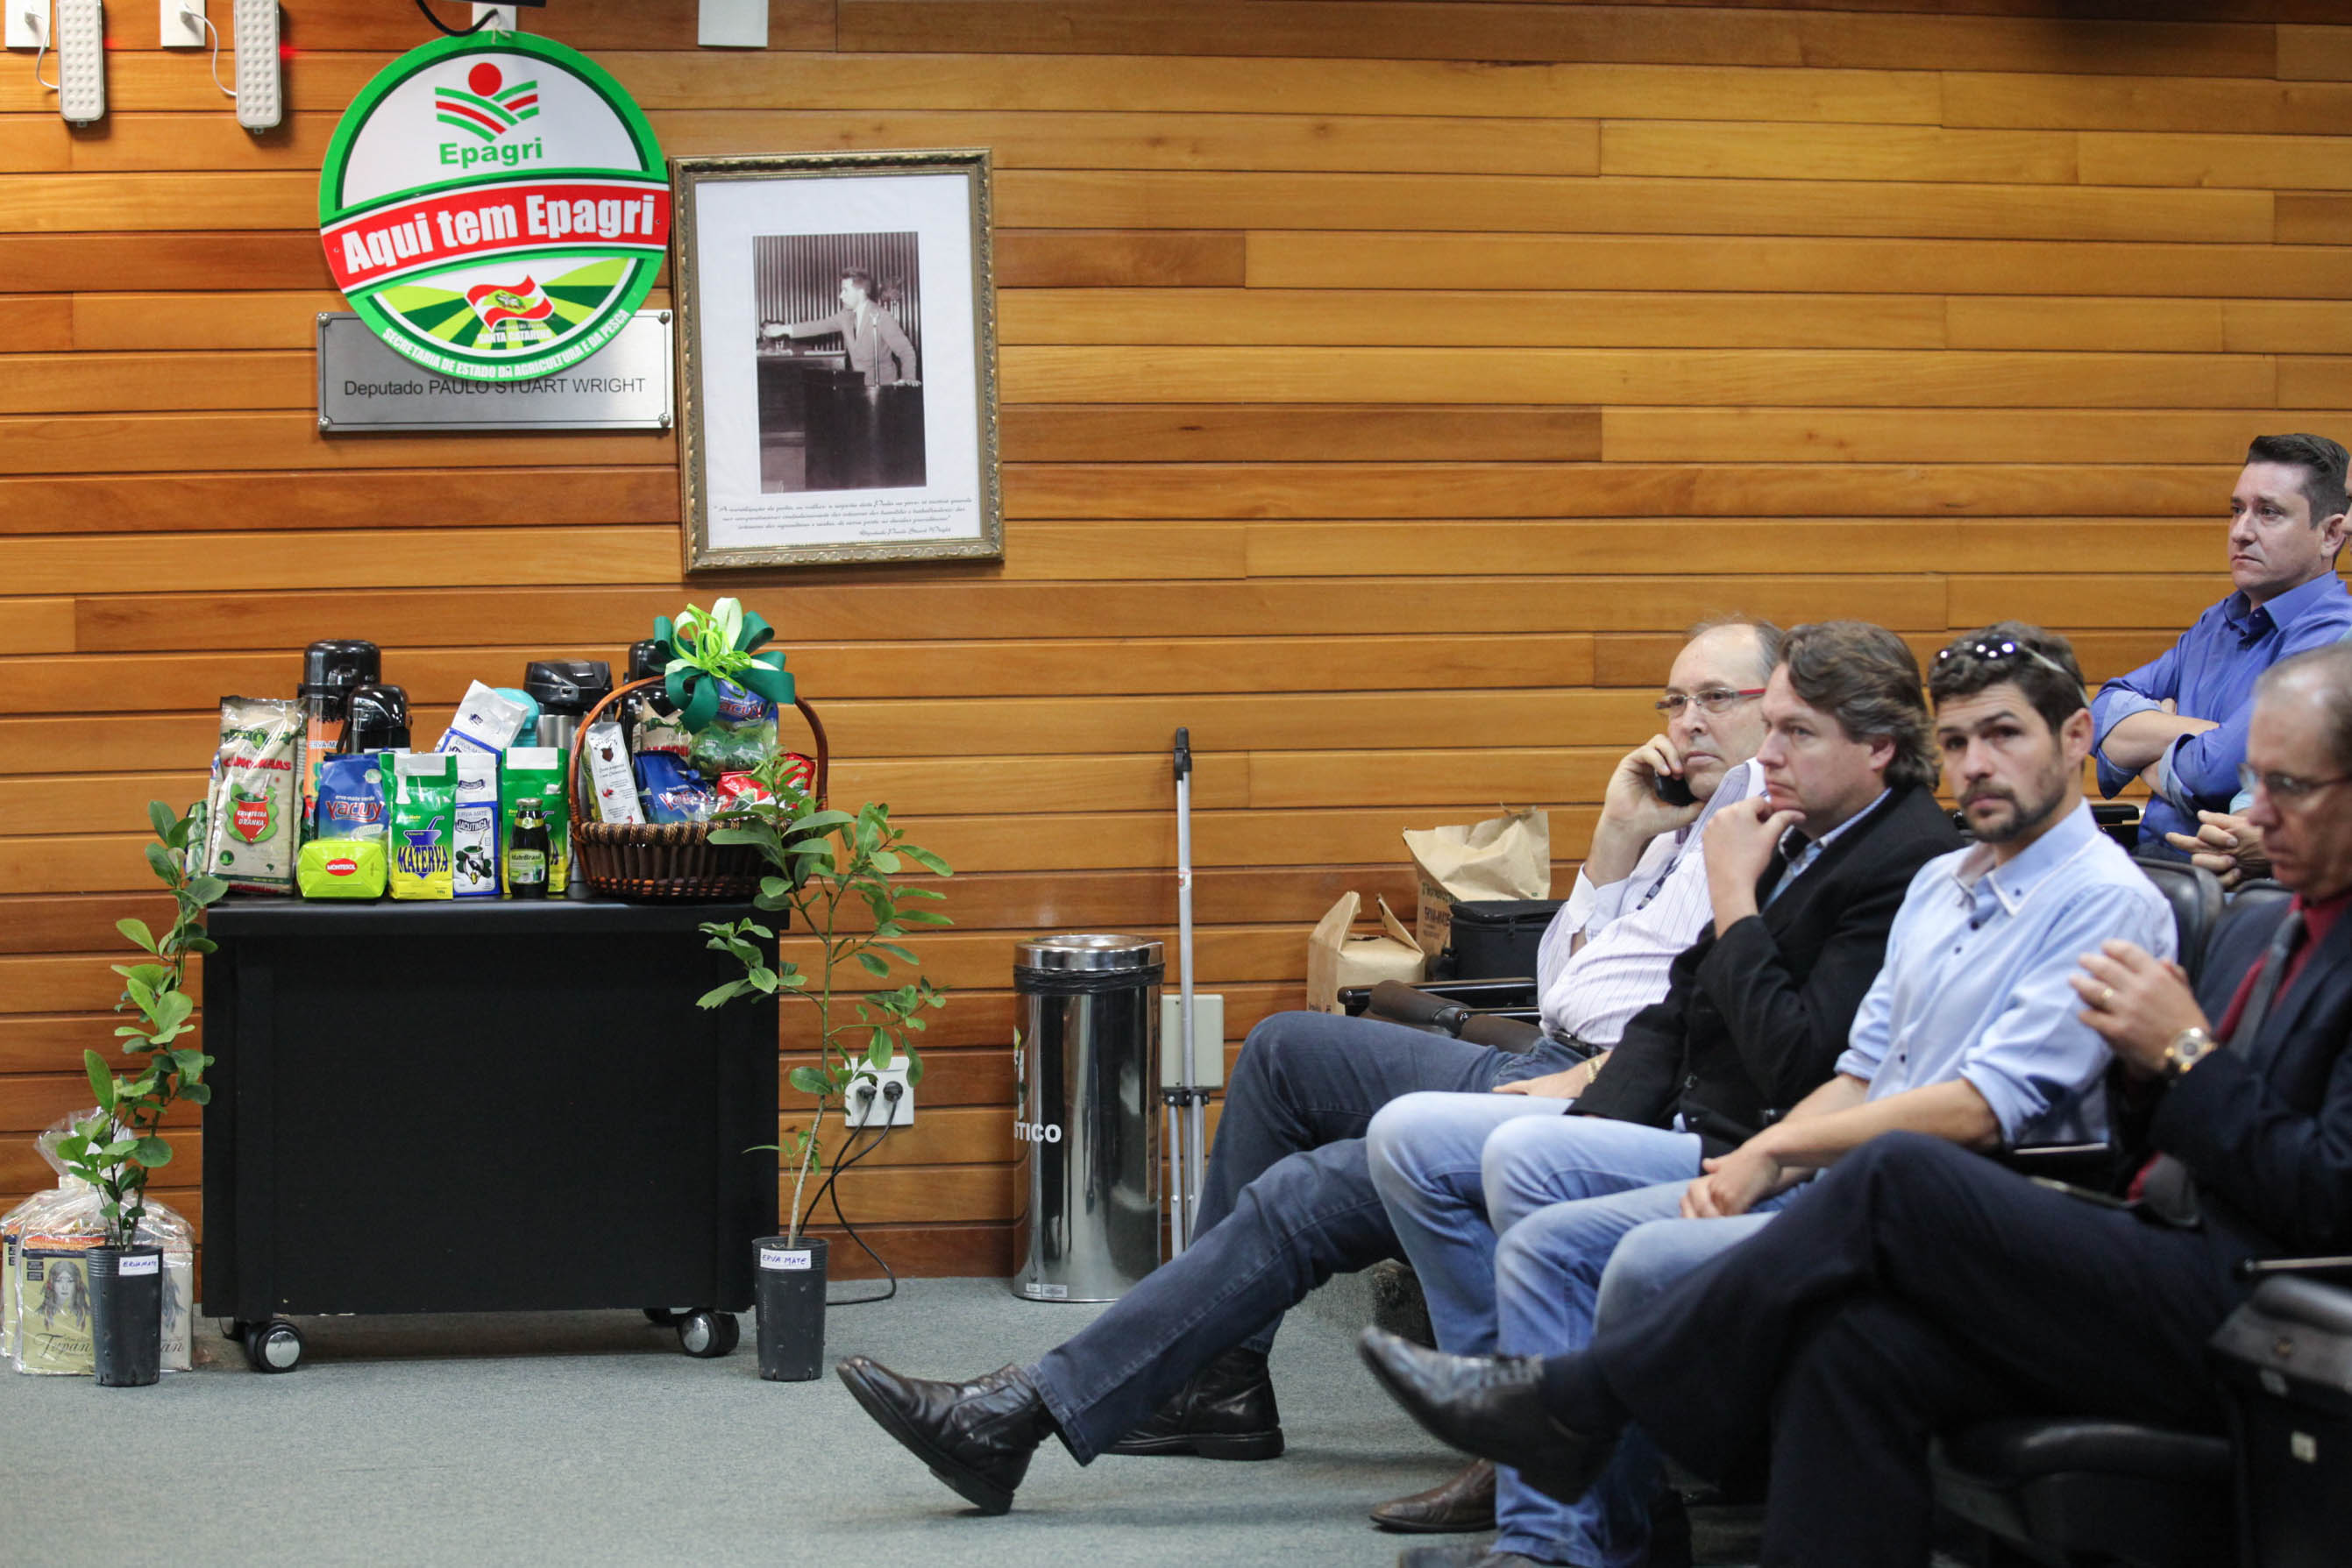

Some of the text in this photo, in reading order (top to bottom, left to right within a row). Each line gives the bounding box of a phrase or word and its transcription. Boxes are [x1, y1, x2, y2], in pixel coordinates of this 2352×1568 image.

[439, 137, 544, 169] Epagri
[341, 195, 656, 274] Aqui tem Epagri
[383, 309, 631, 378] SECRETARIA DE ESTADO DA AGRICULTURA E DA PESCA
[345, 378, 645, 399] Deputado PAULO STUART WRIGHT
[398, 846, 448, 873] MATERVA
[785, 1257, 807, 1266] MATE
